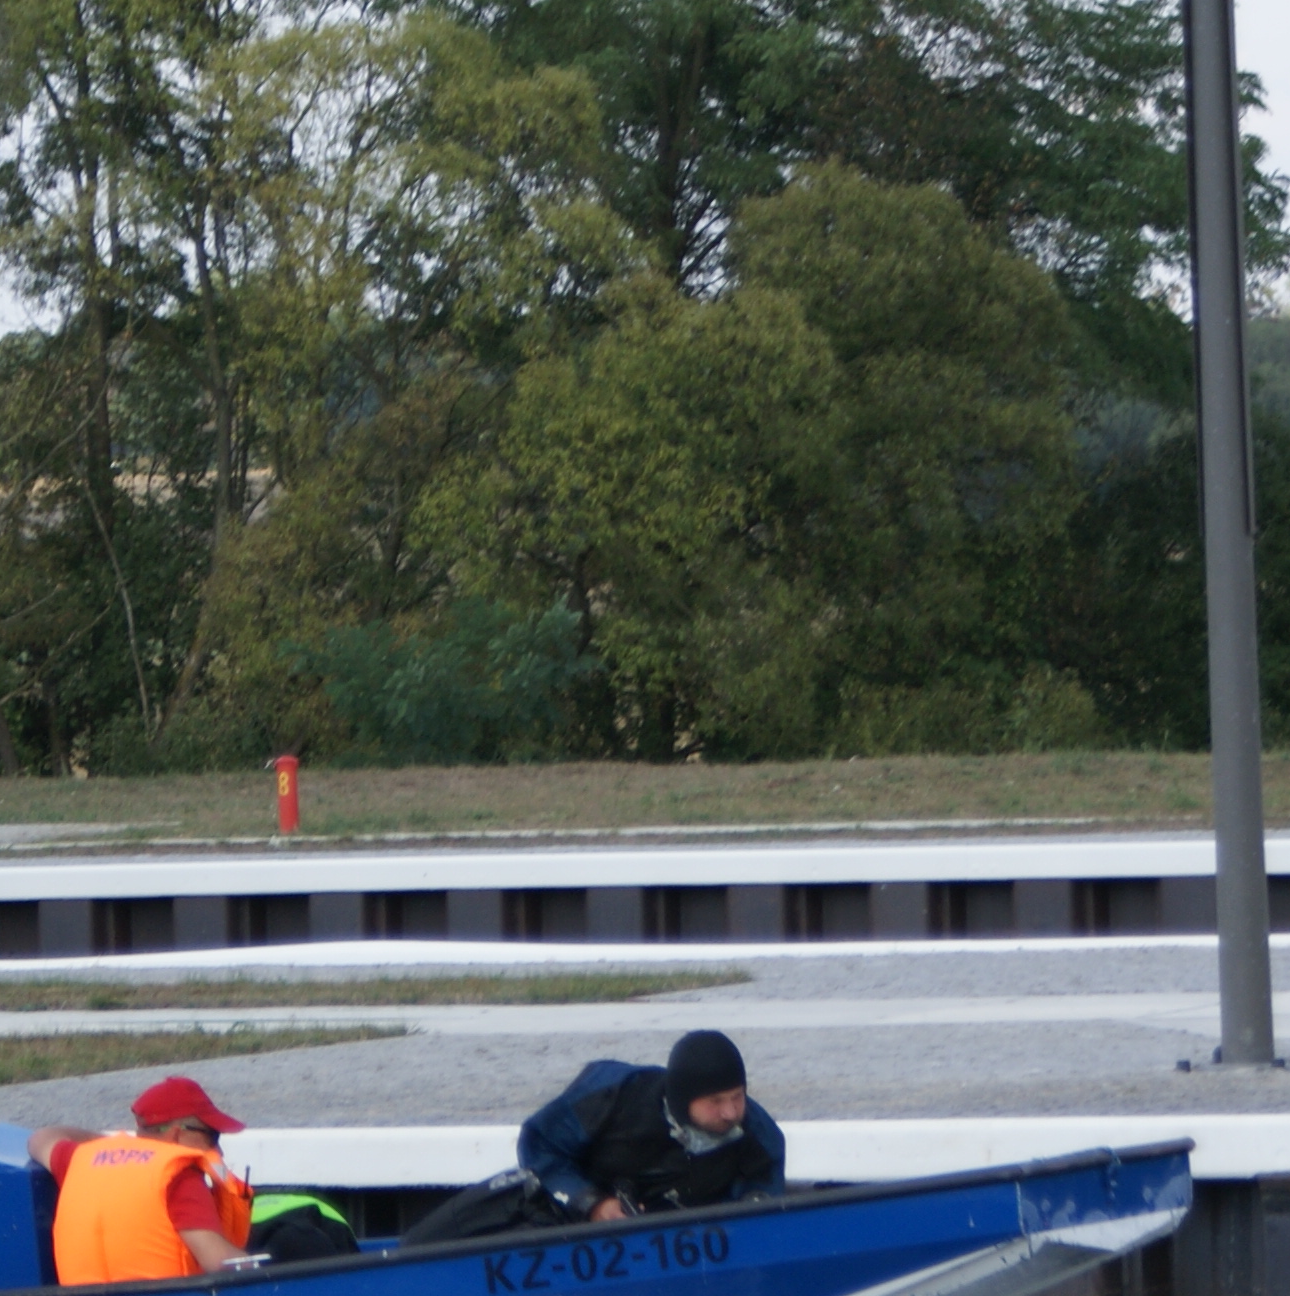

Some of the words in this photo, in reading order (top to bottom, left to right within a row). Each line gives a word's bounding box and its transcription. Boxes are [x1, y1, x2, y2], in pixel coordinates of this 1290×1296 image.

[278, 770, 290, 796] 8
[92, 1149, 156, 1166] WOPR
[483, 1225, 730, 1295] KZ-02-160
